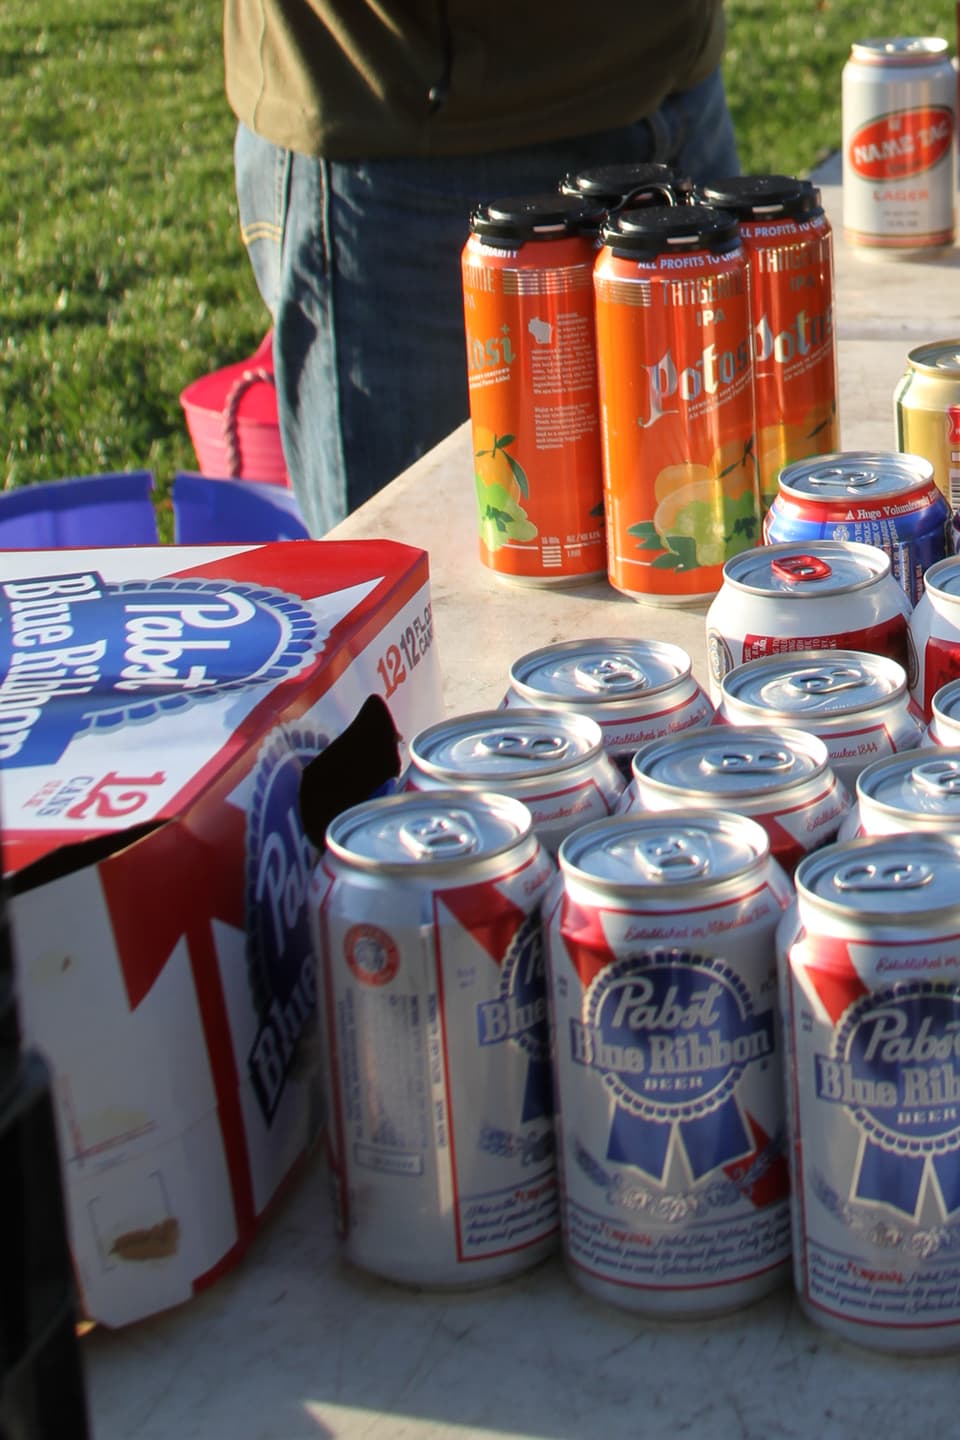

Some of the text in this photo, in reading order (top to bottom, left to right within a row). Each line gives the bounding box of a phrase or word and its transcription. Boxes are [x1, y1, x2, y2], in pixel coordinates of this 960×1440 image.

[754, 224, 797, 237] PROFITS
[660, 256, 705, 270] PROFITS
[697, 308, 725, 326] IPA
[637, 339, 750, 428] Potos
[845, 510, 855, 520] A
[857, 509, 881, 520] Huge
[3, 574, 103, 648] Blue
[113, 591, 256, 691] Pabst
[400, 626, 420, 671] 12
[377, 644, 407, 699] 12
[603, 730, 656, 746] Established
[857, 741, 878, 754] 1844
[65, 770, 167, 820] 12
[481, 996, 547, 1042] Blue
[608, 975, 722, 1030] Pabst
[575, 1022, 769, 1074] Blue Ribbon
[643, 1076, 703, 1091] BEER
[818, 1059, 897, 1107] Blue
[897, 1107, 957, 1125] BEER
